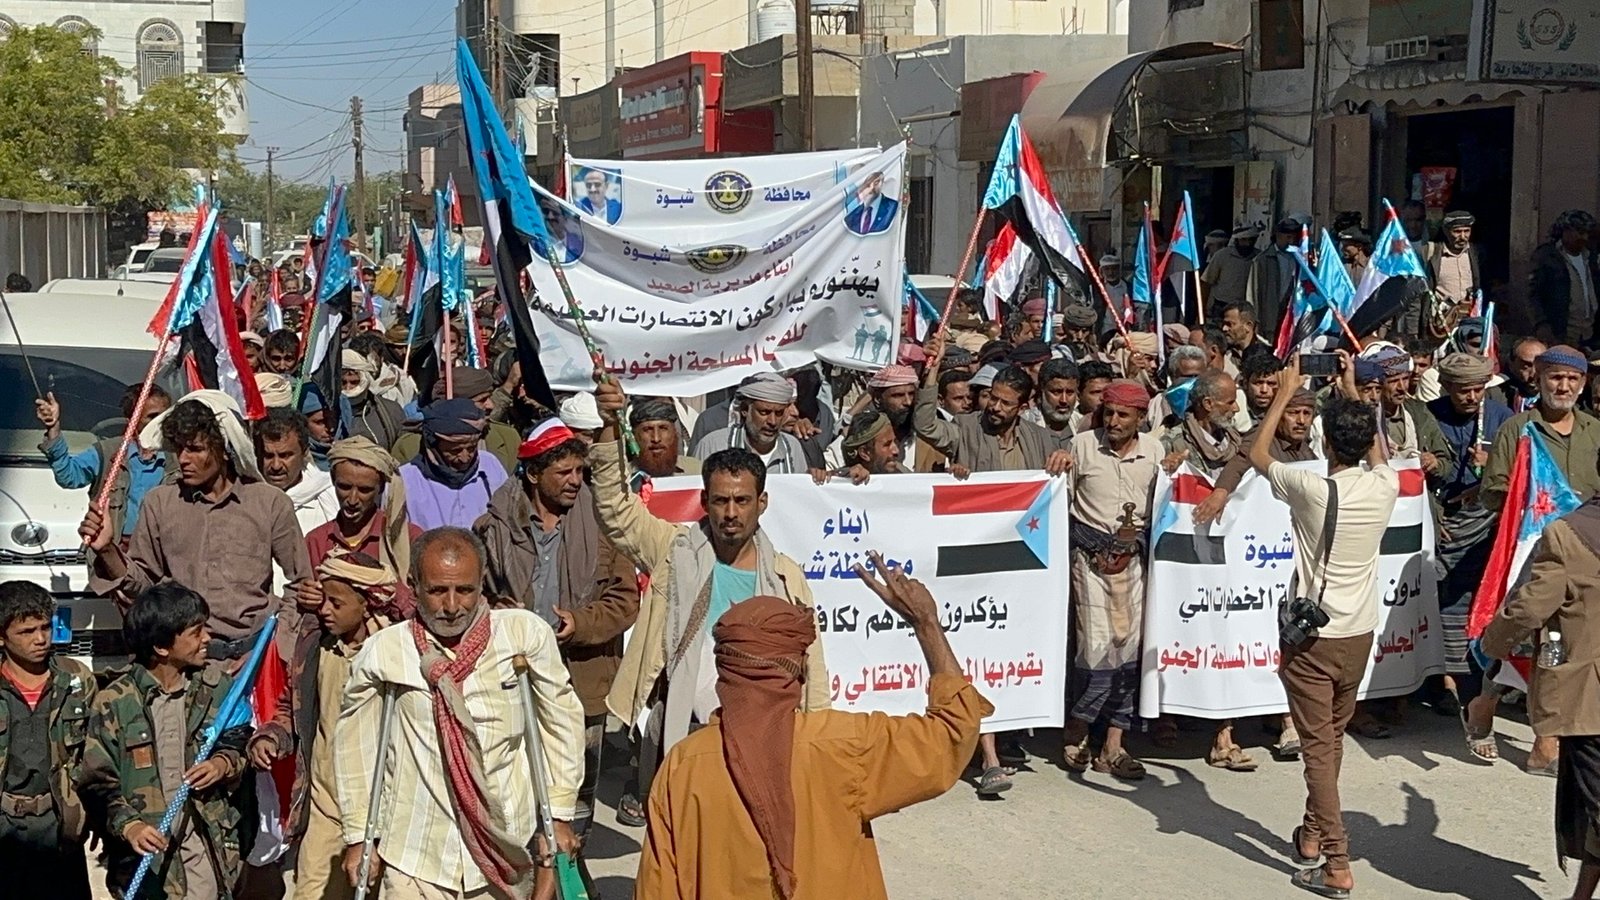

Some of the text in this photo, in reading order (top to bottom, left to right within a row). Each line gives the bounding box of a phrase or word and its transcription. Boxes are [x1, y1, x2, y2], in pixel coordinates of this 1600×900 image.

[656, 186, 811, 209] محافظة شبوة
[622, 240, 671, 265] شبوة
[618, 307, 733, 331] الانتصارات
[686, 341, 759, 371] المسلحة
[823, 507, 869, 543] ابناء
[802, 549, 826, 580] شب
[1244, 532, 1293, 569] شبوة
[845, 662, 922, 706] الانتقالي
[983, 658, 1004, 689] بها
[1006, 652, 1044, 688] يقوم
